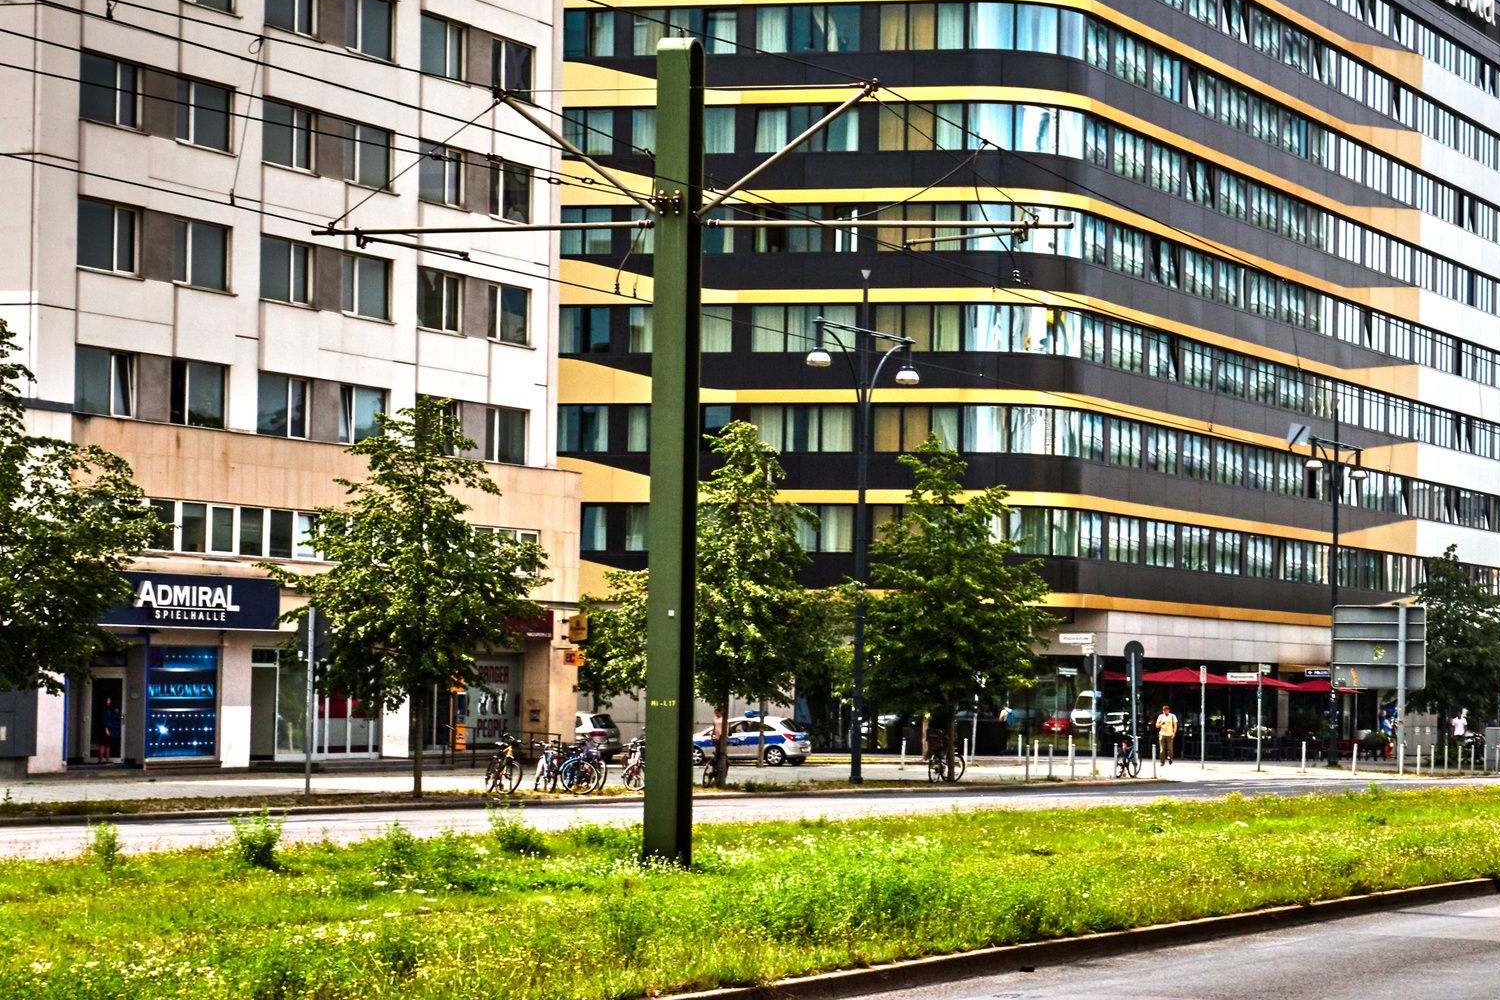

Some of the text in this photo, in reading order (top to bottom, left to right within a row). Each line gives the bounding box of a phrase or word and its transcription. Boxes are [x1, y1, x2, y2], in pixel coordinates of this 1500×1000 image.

[134, 580, 241, 612] ADMIRAL
[155, 610, 226, 622] SPIELHALLE
[148, 683, 214, 697] WILLKOMMEN
